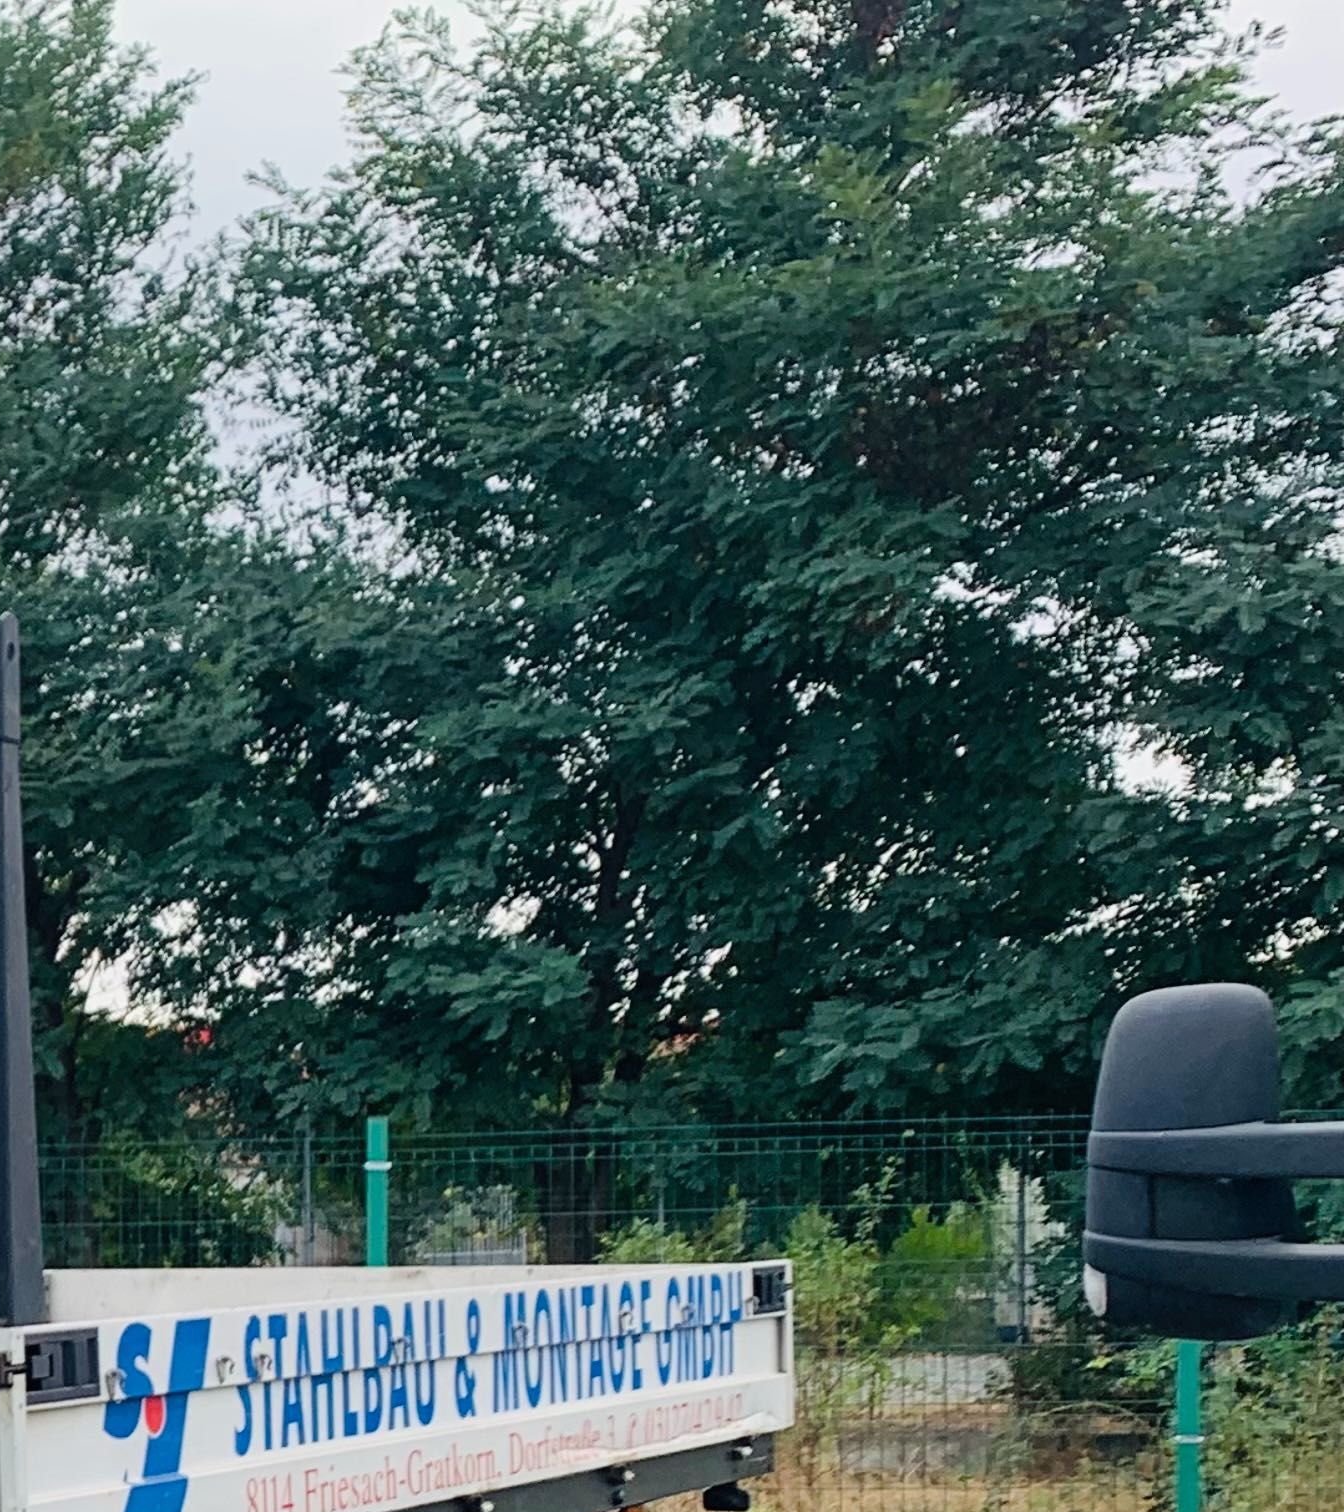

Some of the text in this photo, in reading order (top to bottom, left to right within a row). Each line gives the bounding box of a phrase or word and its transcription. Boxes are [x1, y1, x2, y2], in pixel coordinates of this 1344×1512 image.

[233, 1298, 446, 1457] STAHLBAU
[454, 1297, 481, 1419] &
[492, 1278, 651, 1414] MONTAGE
